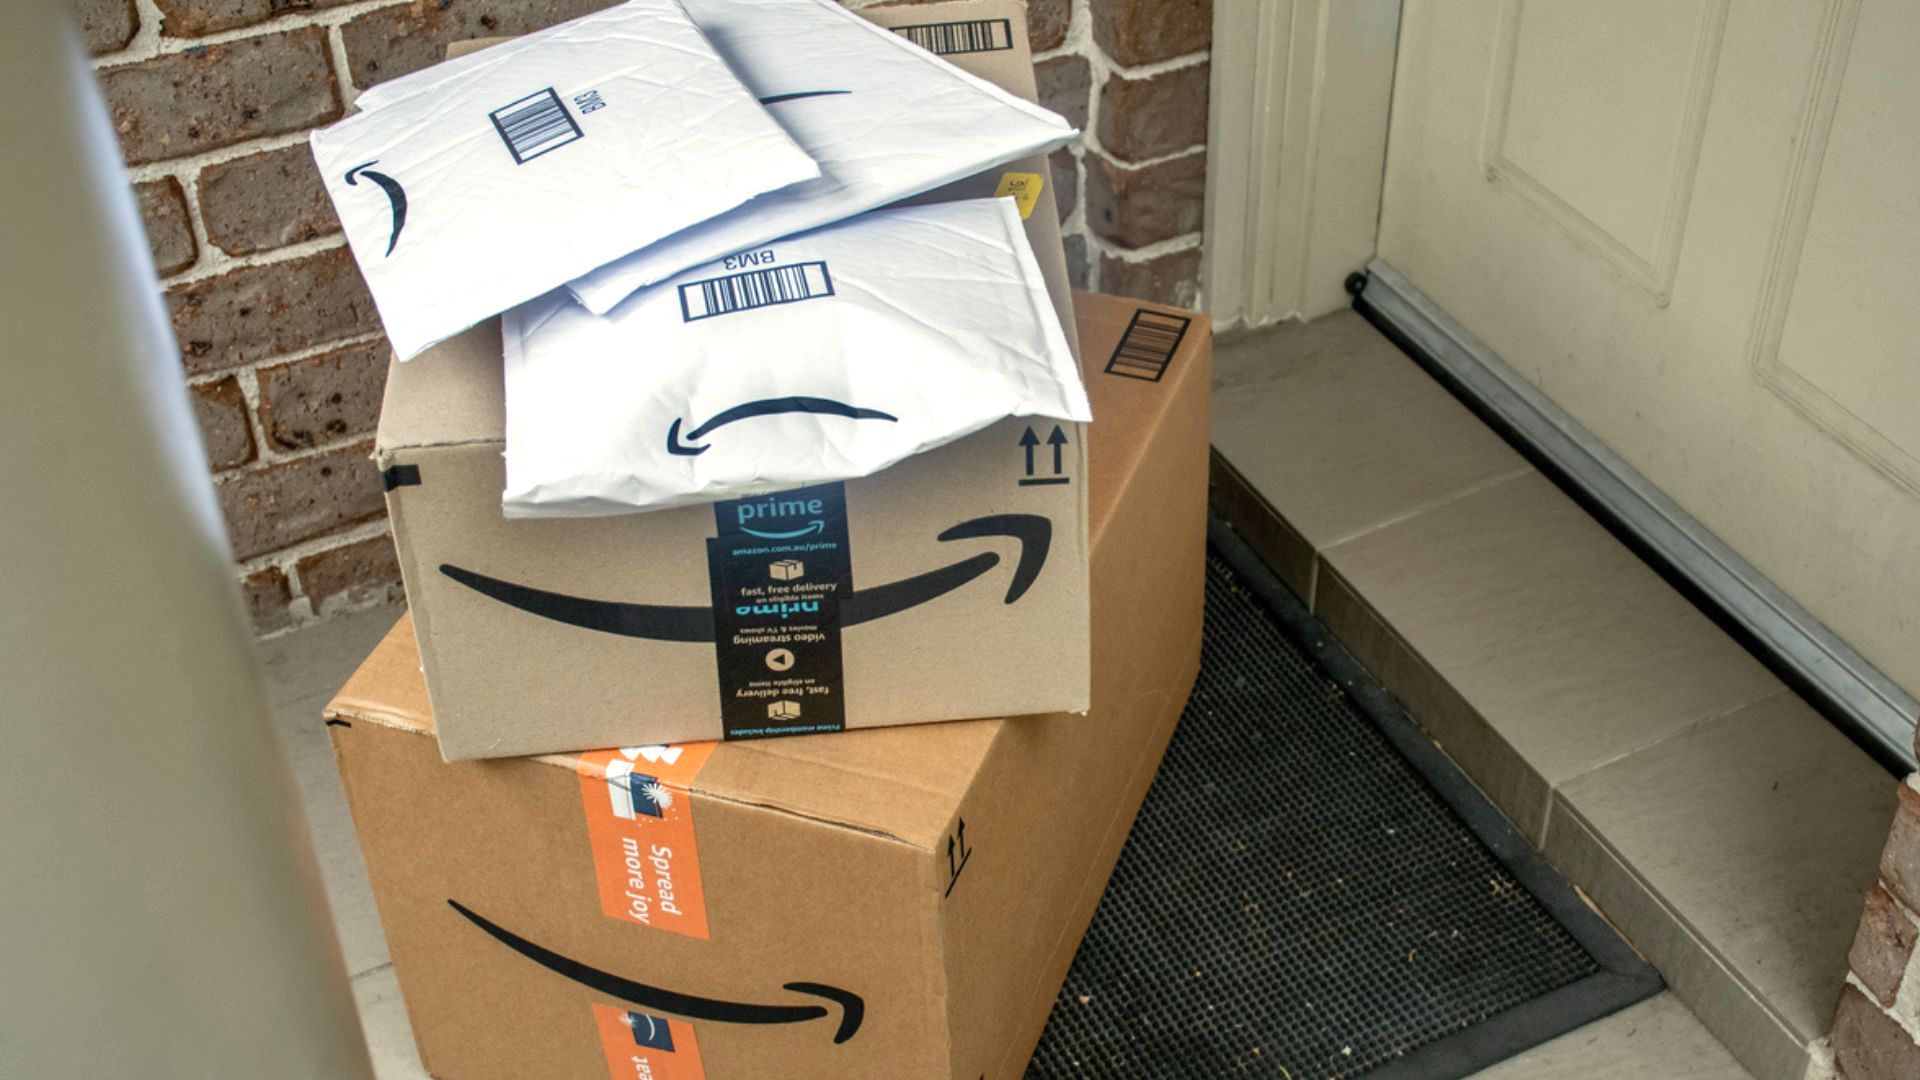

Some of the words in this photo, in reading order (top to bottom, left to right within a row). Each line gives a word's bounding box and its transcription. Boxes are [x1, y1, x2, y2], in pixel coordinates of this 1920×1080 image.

[574, 90, 606, 114] BM3
[723, 249, 776, 271] BM3
[737, 497, 823, 524] prime
[732, 542, 837, 556] amazon.com.au/prime
[741, 587, 765, 597] fast,
[768, 584, 790, 594] free
[793, 582, 837, 593] delivery
[769, 595, 799, 603] eligible
[733, 635, 791, 646] streaming
[794, 633, 826, 643] video
[774, 678, 803, 686] eligible
[736, 688, 780, 698] delivery
[782, 687, 804, 696] free
[806, 686, 829, 695] fast,
[730, 728, 764, 736] includes
[766, 725, 815, 733] membership
[622, 837, 644, 889] more
[648, 844, 682, 915] Spread
[625, 889, 652, 924] joy
